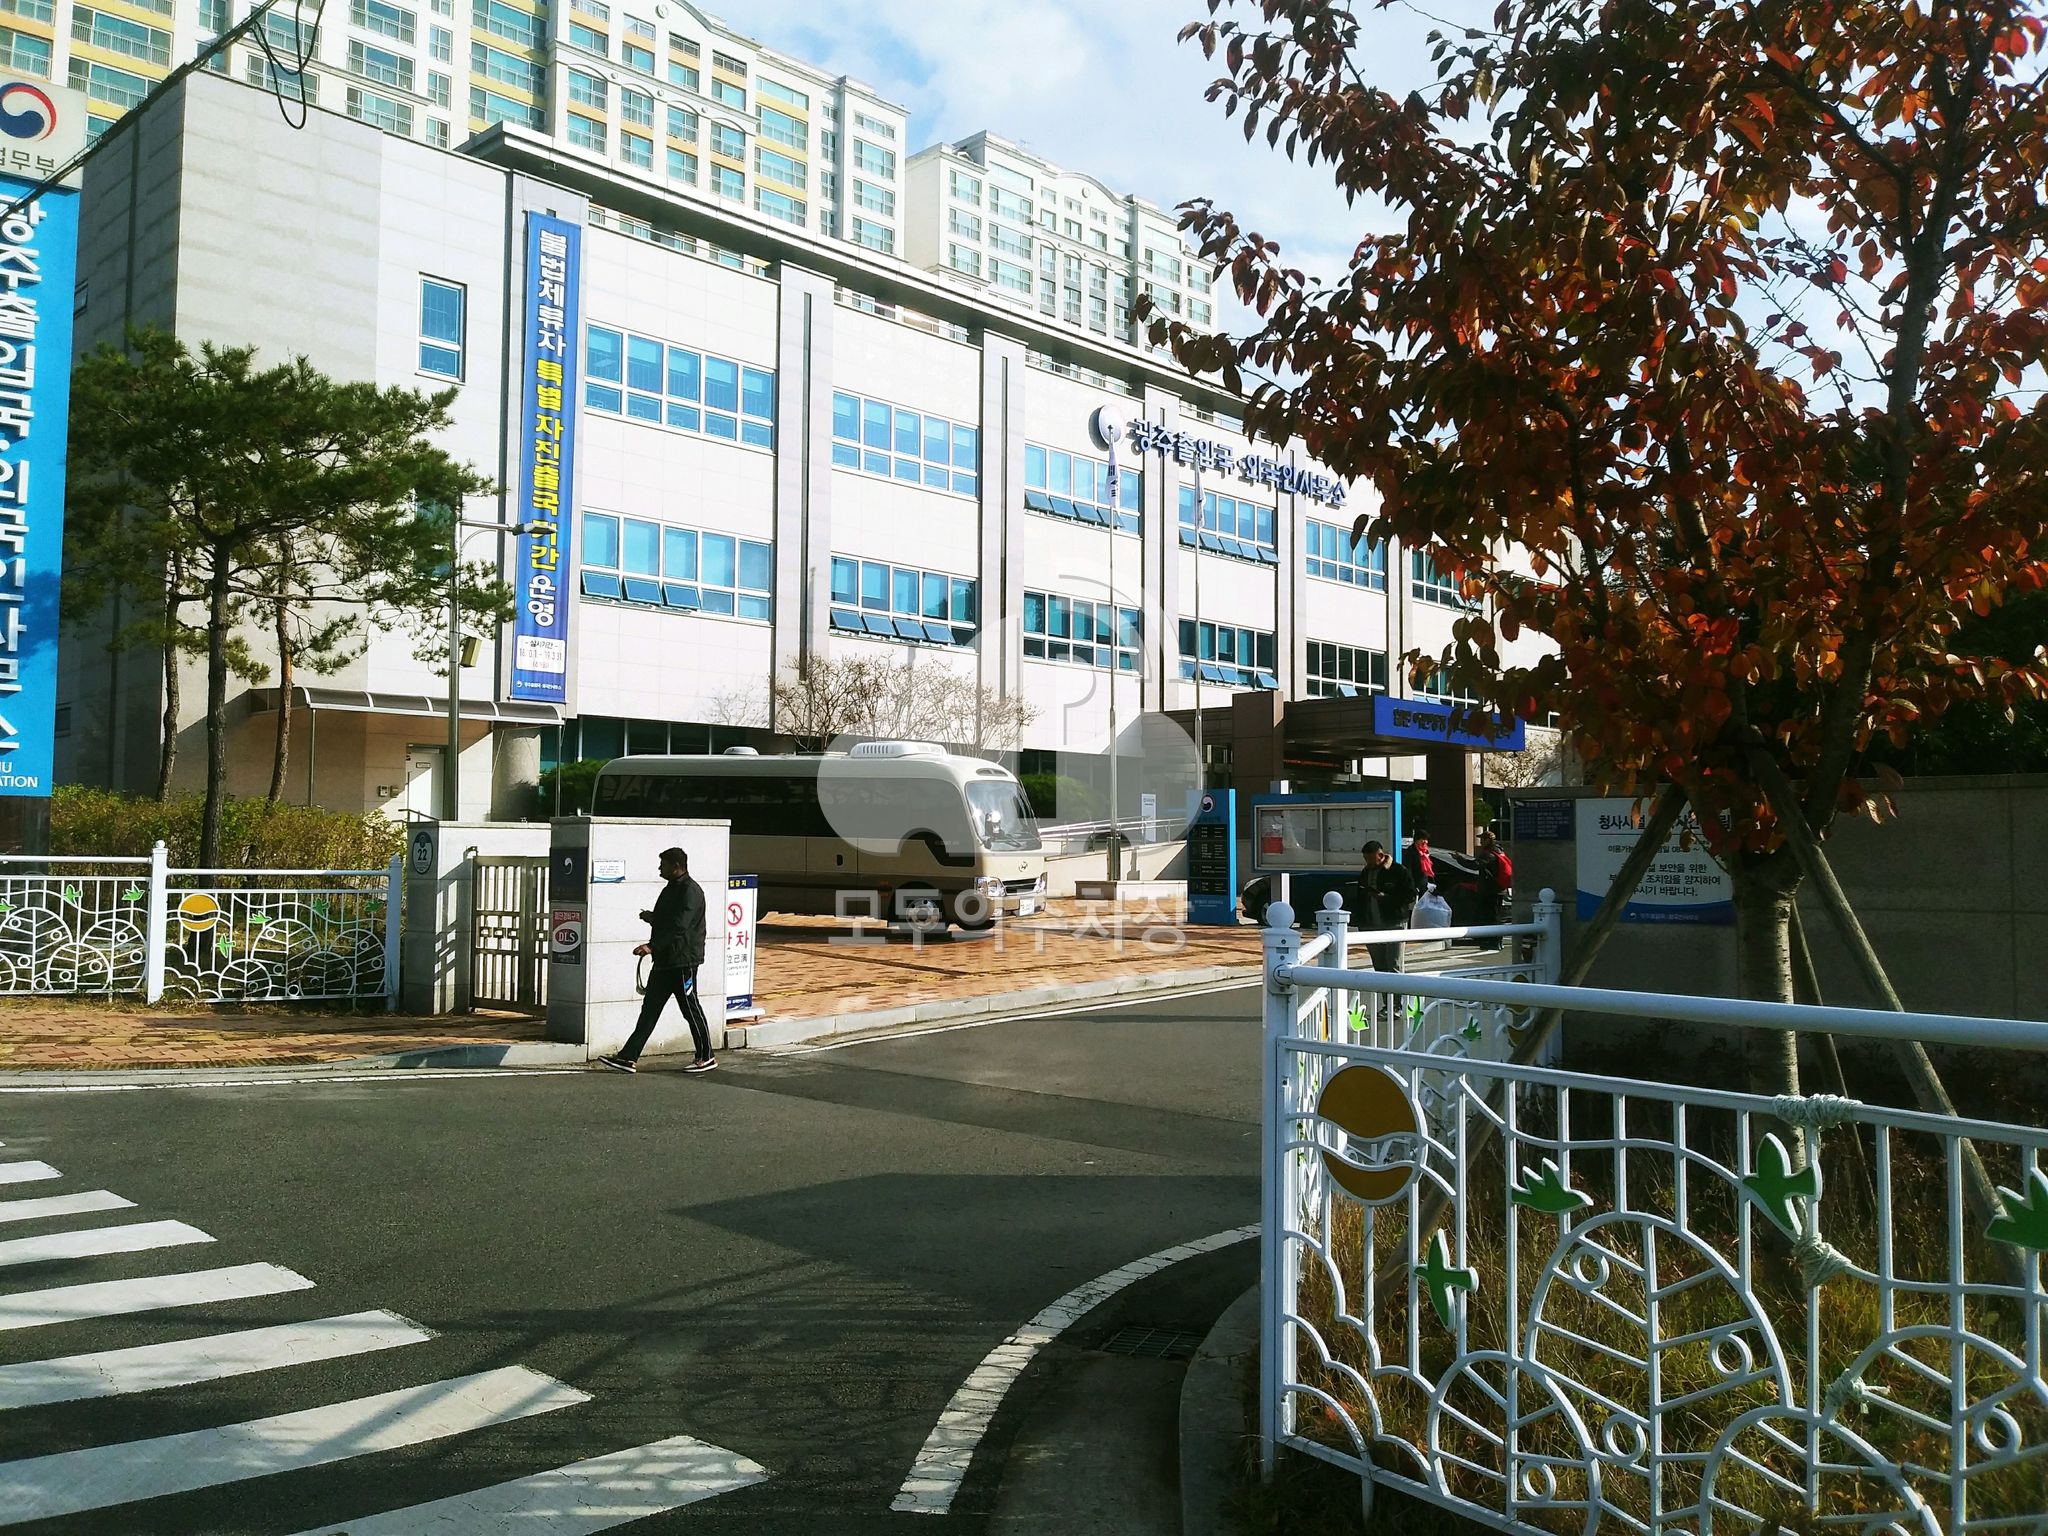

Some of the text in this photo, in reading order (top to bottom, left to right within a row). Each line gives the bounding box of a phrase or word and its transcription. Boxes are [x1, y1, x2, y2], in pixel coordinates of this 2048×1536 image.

[537, 229, 567, 358] 불법체류자
[536, 357, 563, 412] 특별
[532, 413, 564, 516] 자진출국
[527, 573, 557, 628] 운영
[417, 848, 428, 861] 22
[1659, 863, 1685, 873] 보안을
[1689, 863, 1707, 873] 위한
[1646, 874, 1721, 886] 조치임을 양지하여
[558, 931, 576, 943] DLS
